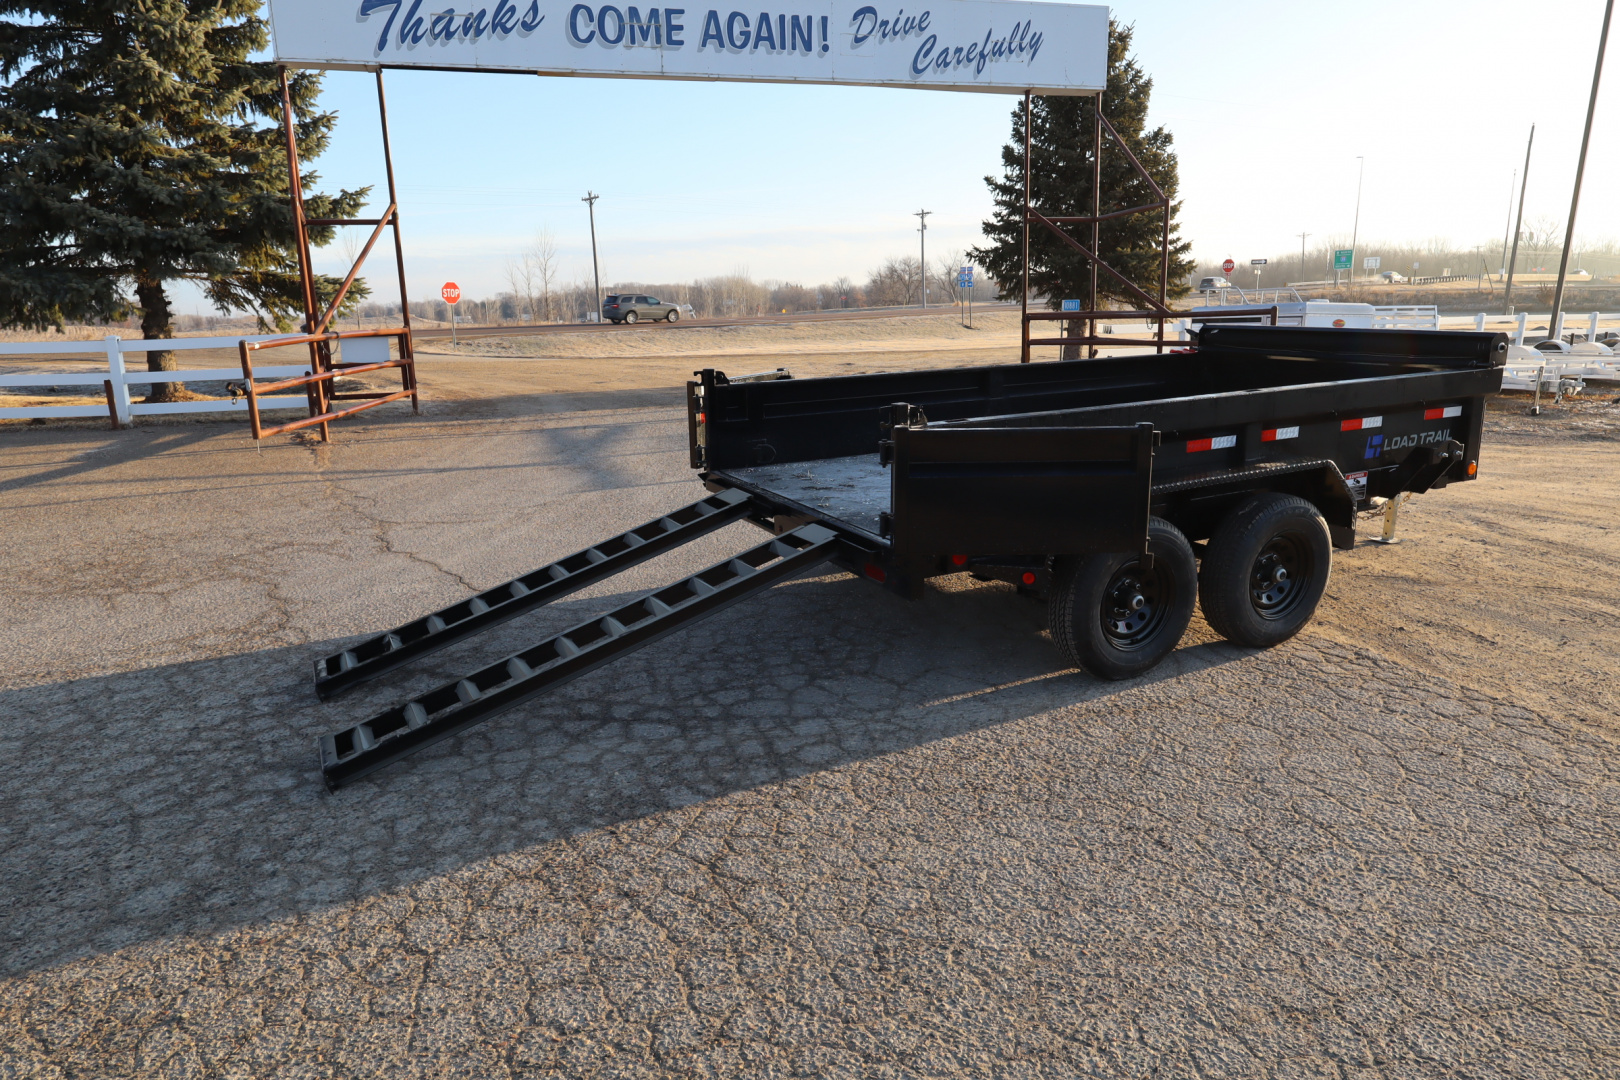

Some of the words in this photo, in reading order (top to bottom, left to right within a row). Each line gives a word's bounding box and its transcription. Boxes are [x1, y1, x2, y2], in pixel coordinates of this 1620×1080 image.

[360, 0, 545, 52] Thanks
[569, 4, 686, 46] COME
[701, 10, 830, 53] AGAIN!
[852, 6, 932, 44] Drive
[912, 20, 1044, 75] Carefully
[443, 289, 459, 297] STOP
[1383, 434, 1418, 451] LOAD
[1420, 429, 1453, 445] TRAIL
